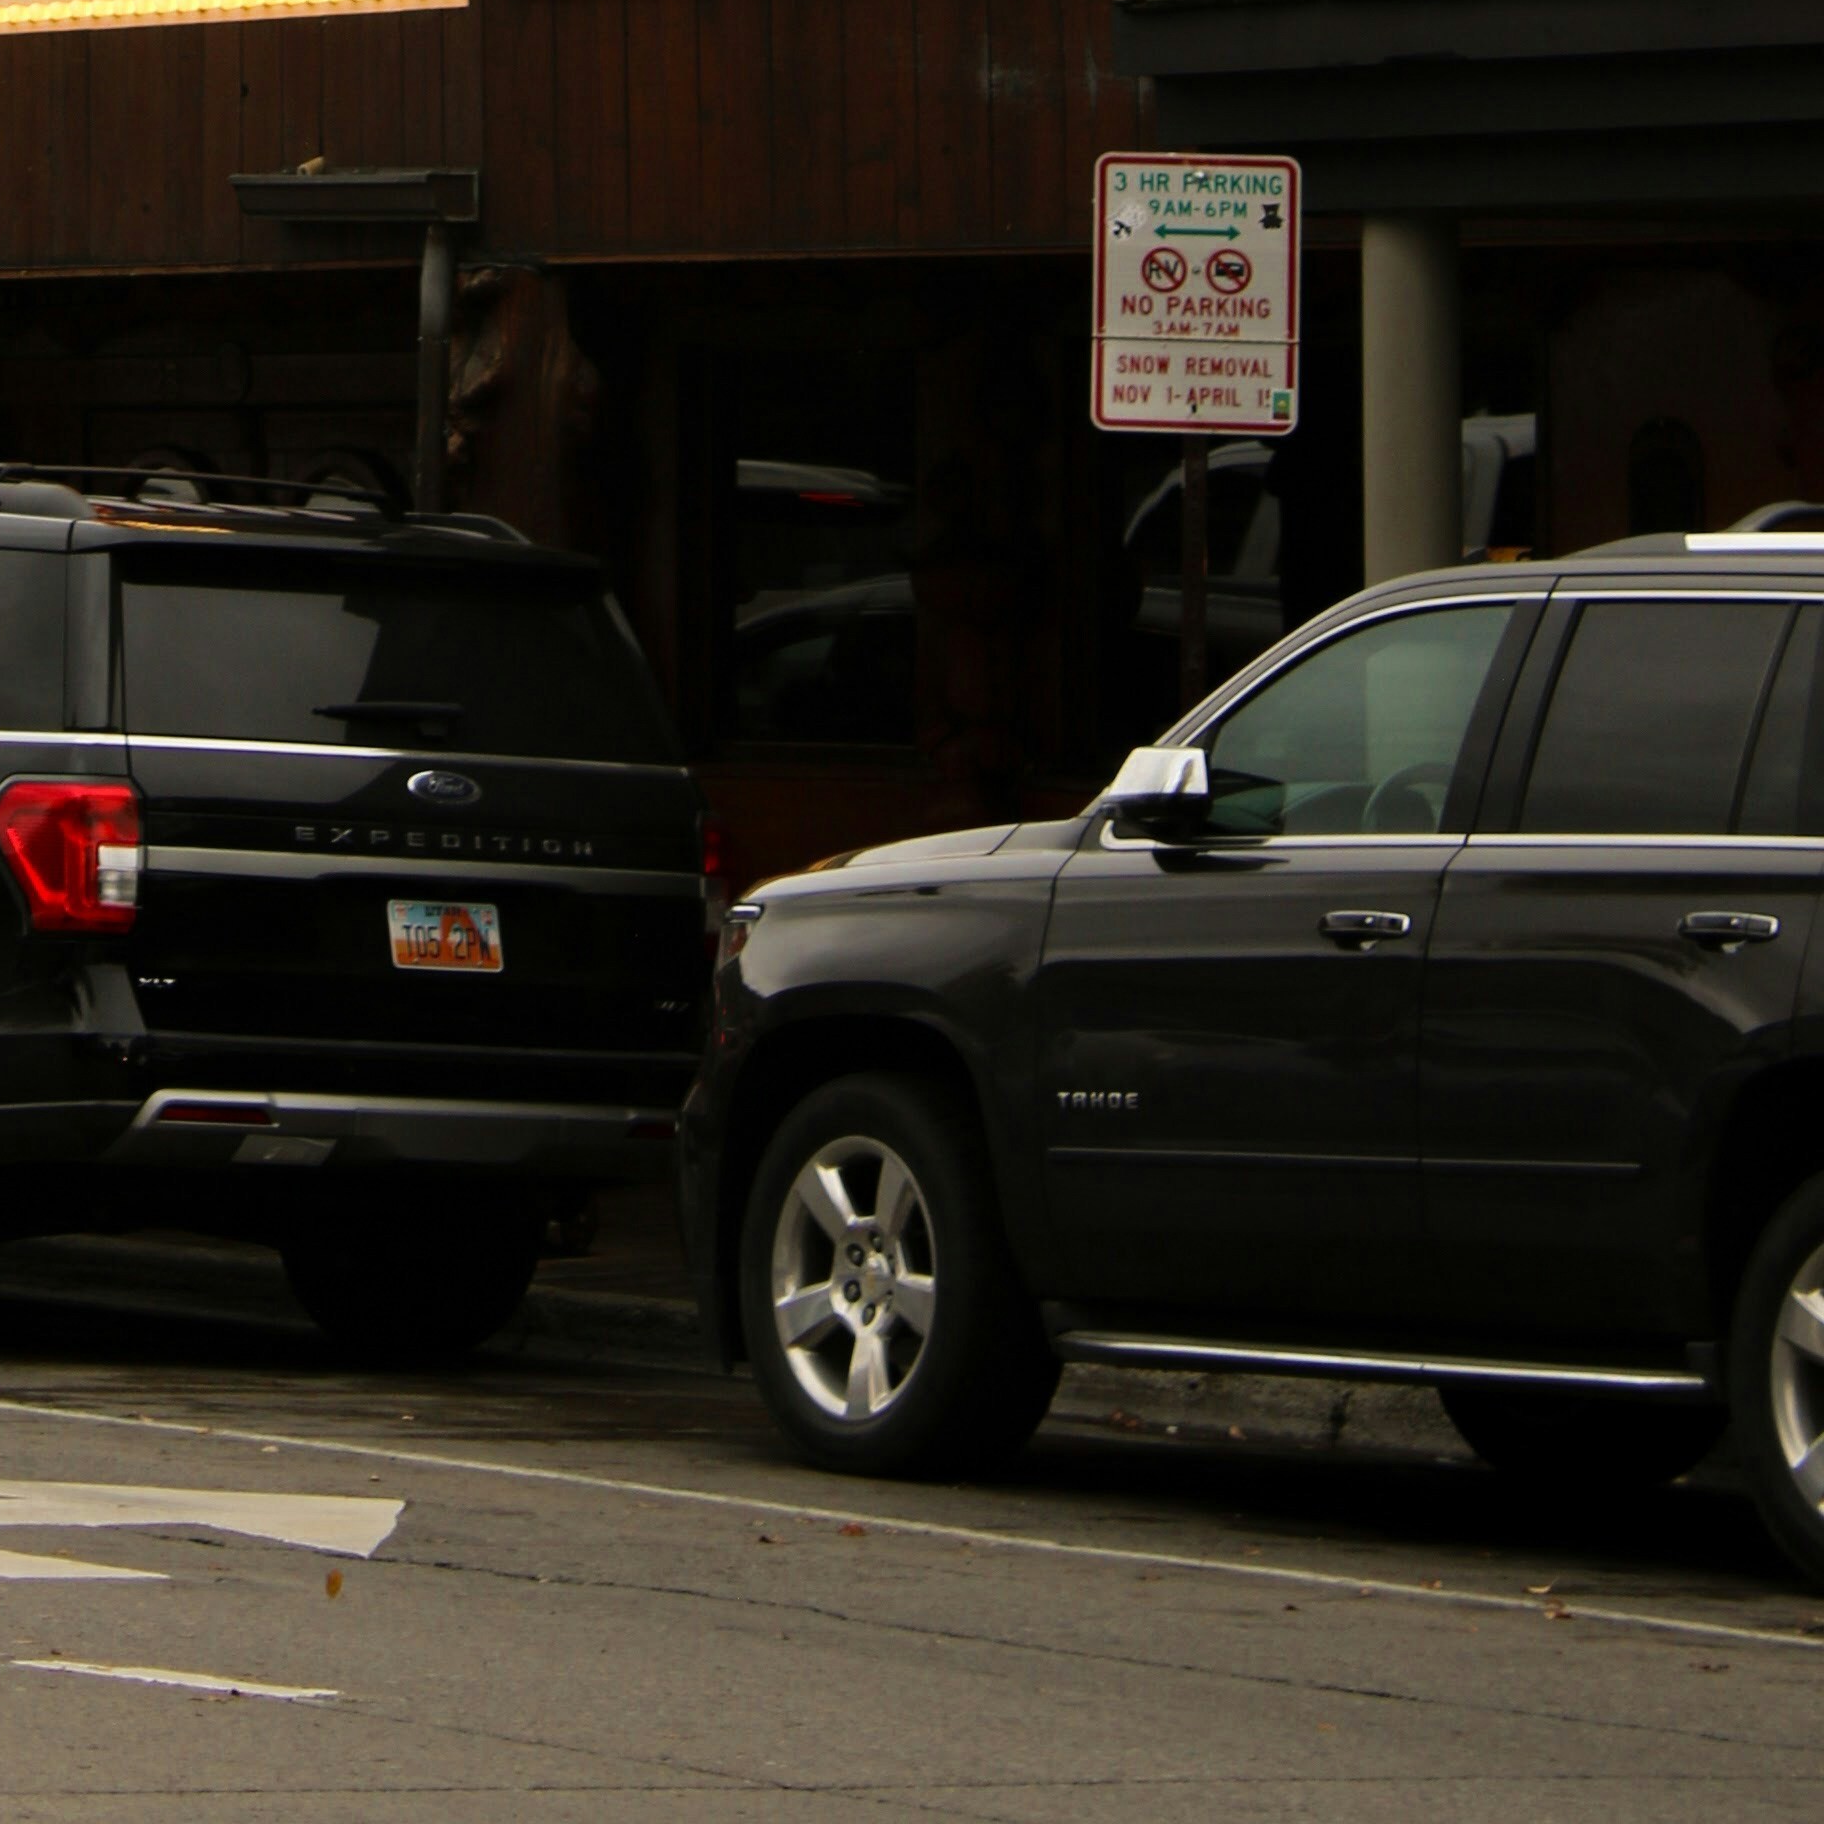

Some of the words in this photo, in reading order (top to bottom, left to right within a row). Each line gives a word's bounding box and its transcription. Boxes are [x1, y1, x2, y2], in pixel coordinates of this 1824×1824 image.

[1114, 172, 1127, 192] 3
[1140, 172, 1170, 193] HR
[1183, 172, 1283, 195] PARKING
[1148, 200, 1247, 218] 9AM-6PM
[1121, 295, 1153, 315] NO
[1167, 296, 1271, 319] PARKING
[1117, 356, 1170, 375] SNOW
[1185, 357, 1273, 378] REMOVAL
[1113, 384, 1152, 403] NOV
[427, 774, 467, 795] Ford
[295, 826, 592, 856] EXPEDITION
[1055, 1090, 1140, 1111] TAHOE
